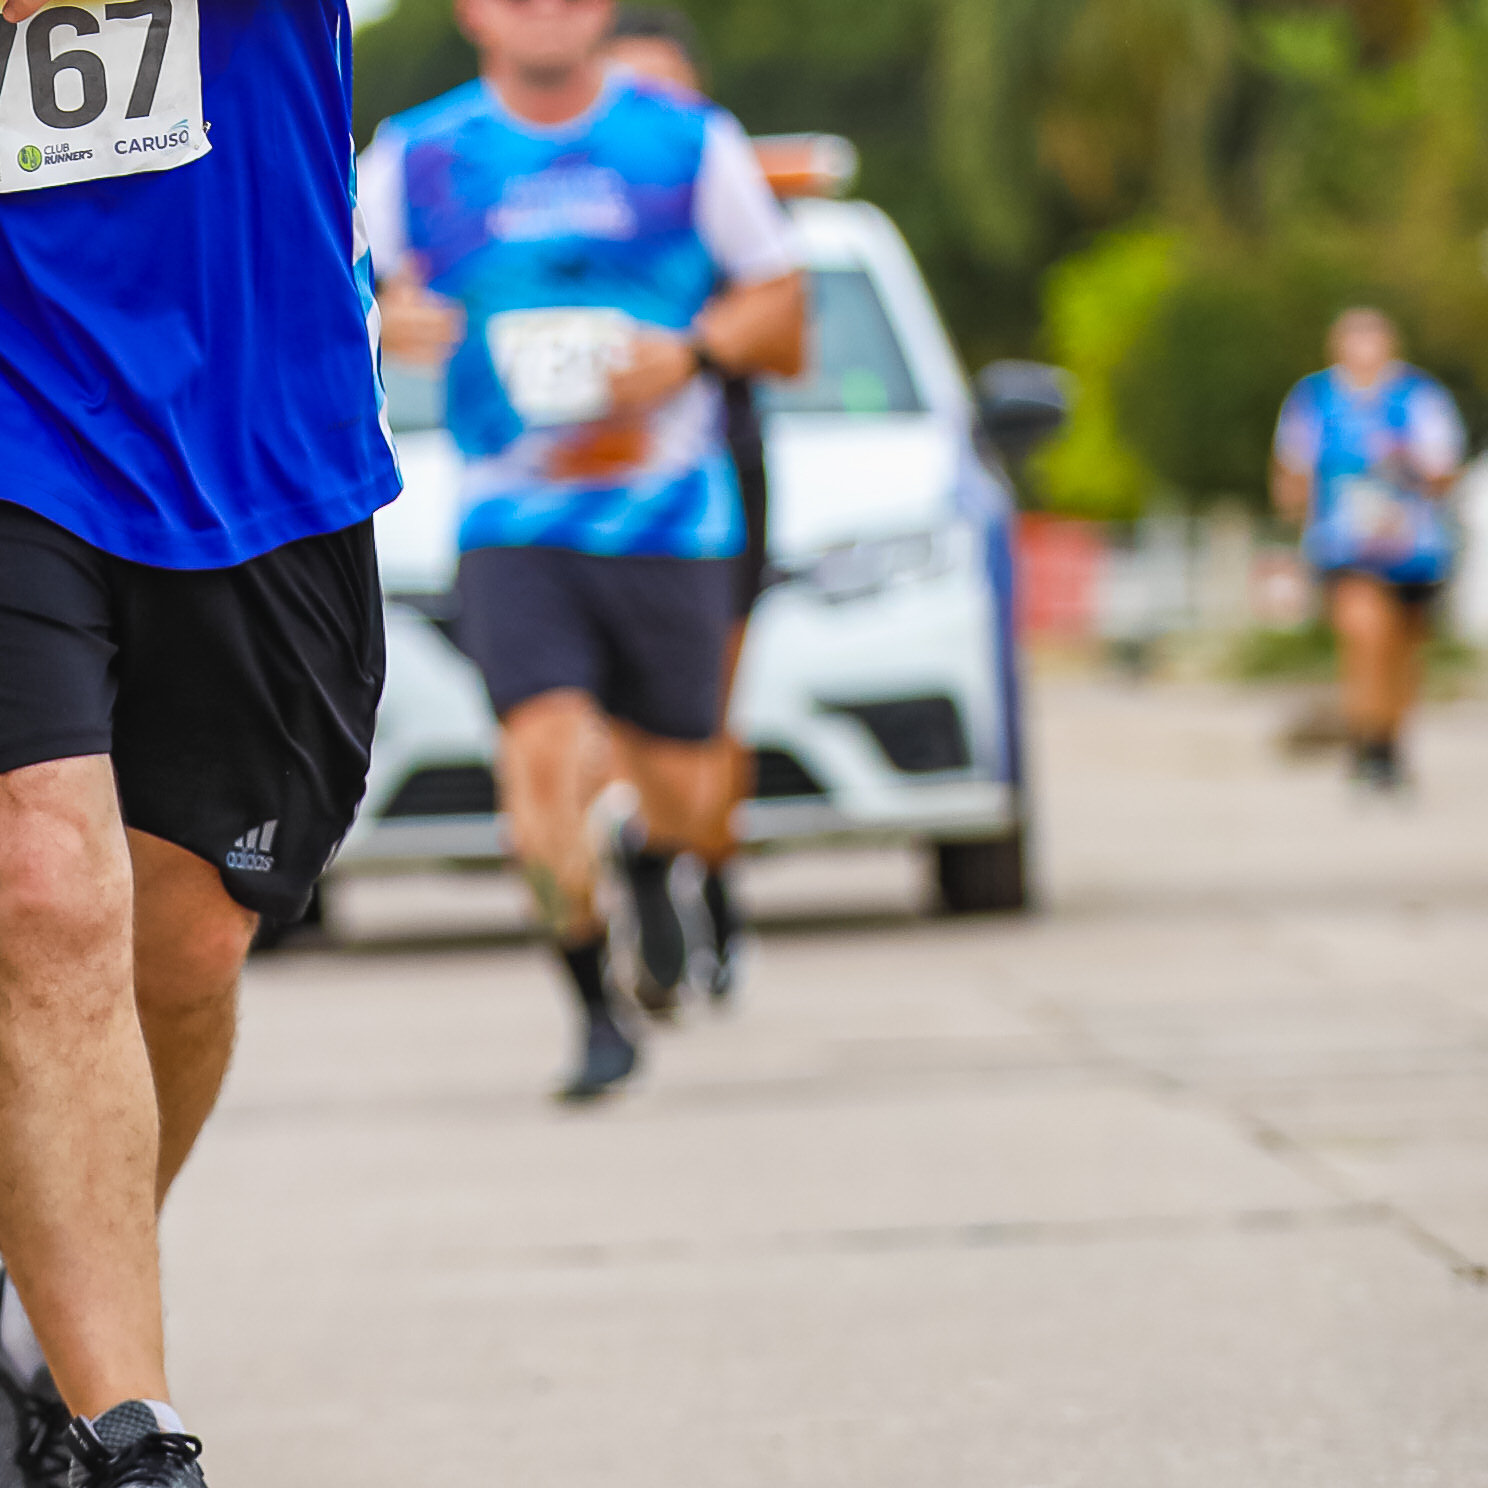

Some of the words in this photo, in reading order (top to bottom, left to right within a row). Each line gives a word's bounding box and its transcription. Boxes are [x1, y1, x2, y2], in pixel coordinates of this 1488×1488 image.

[44, 142, 69, 154] CLUB
[114, 130, 189, 154] CARUSO
[44, 149, 93, 165] RUNNER'S
[226, 849, 275, 871] adidas
